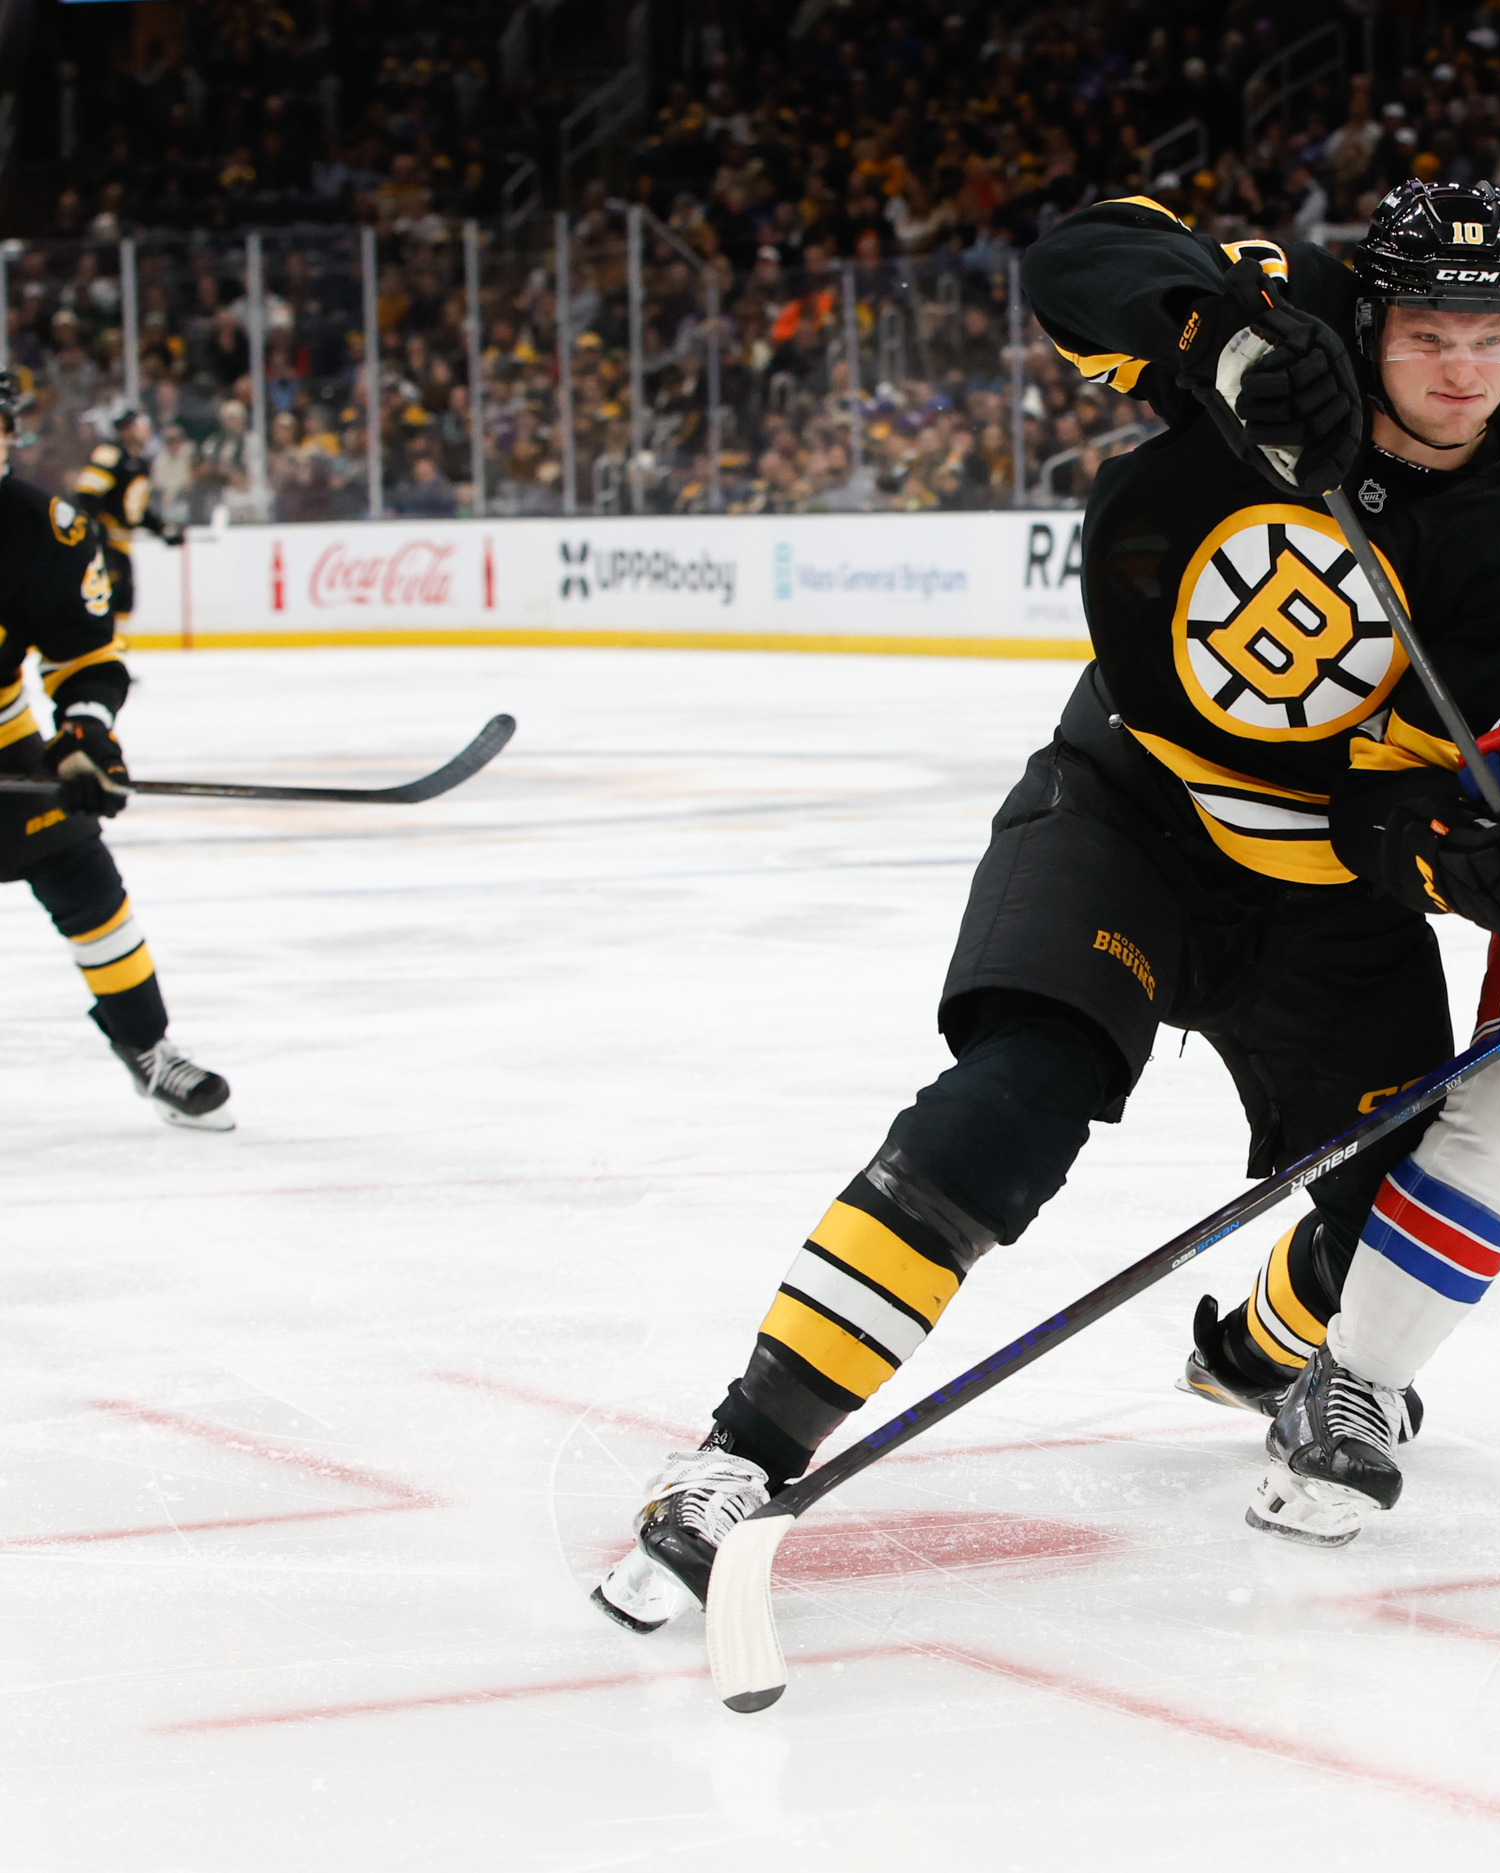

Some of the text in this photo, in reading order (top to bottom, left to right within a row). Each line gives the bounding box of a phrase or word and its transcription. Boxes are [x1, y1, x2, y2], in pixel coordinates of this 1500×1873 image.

[1452, 221, 1484, 246] 10
[1436, 269, 1500, 283] CCM
[1178, 311, 1200, 351] CCM
[1207, 548, 1355, 699] B
[1092, 929, 1156, 1001] BRUINS
[1113, 931, 1151, 974] BOSTON
[1290, 1140, 1359, 1195] BAUER
[1196, 1220, 1241, 1253] NEXUS
